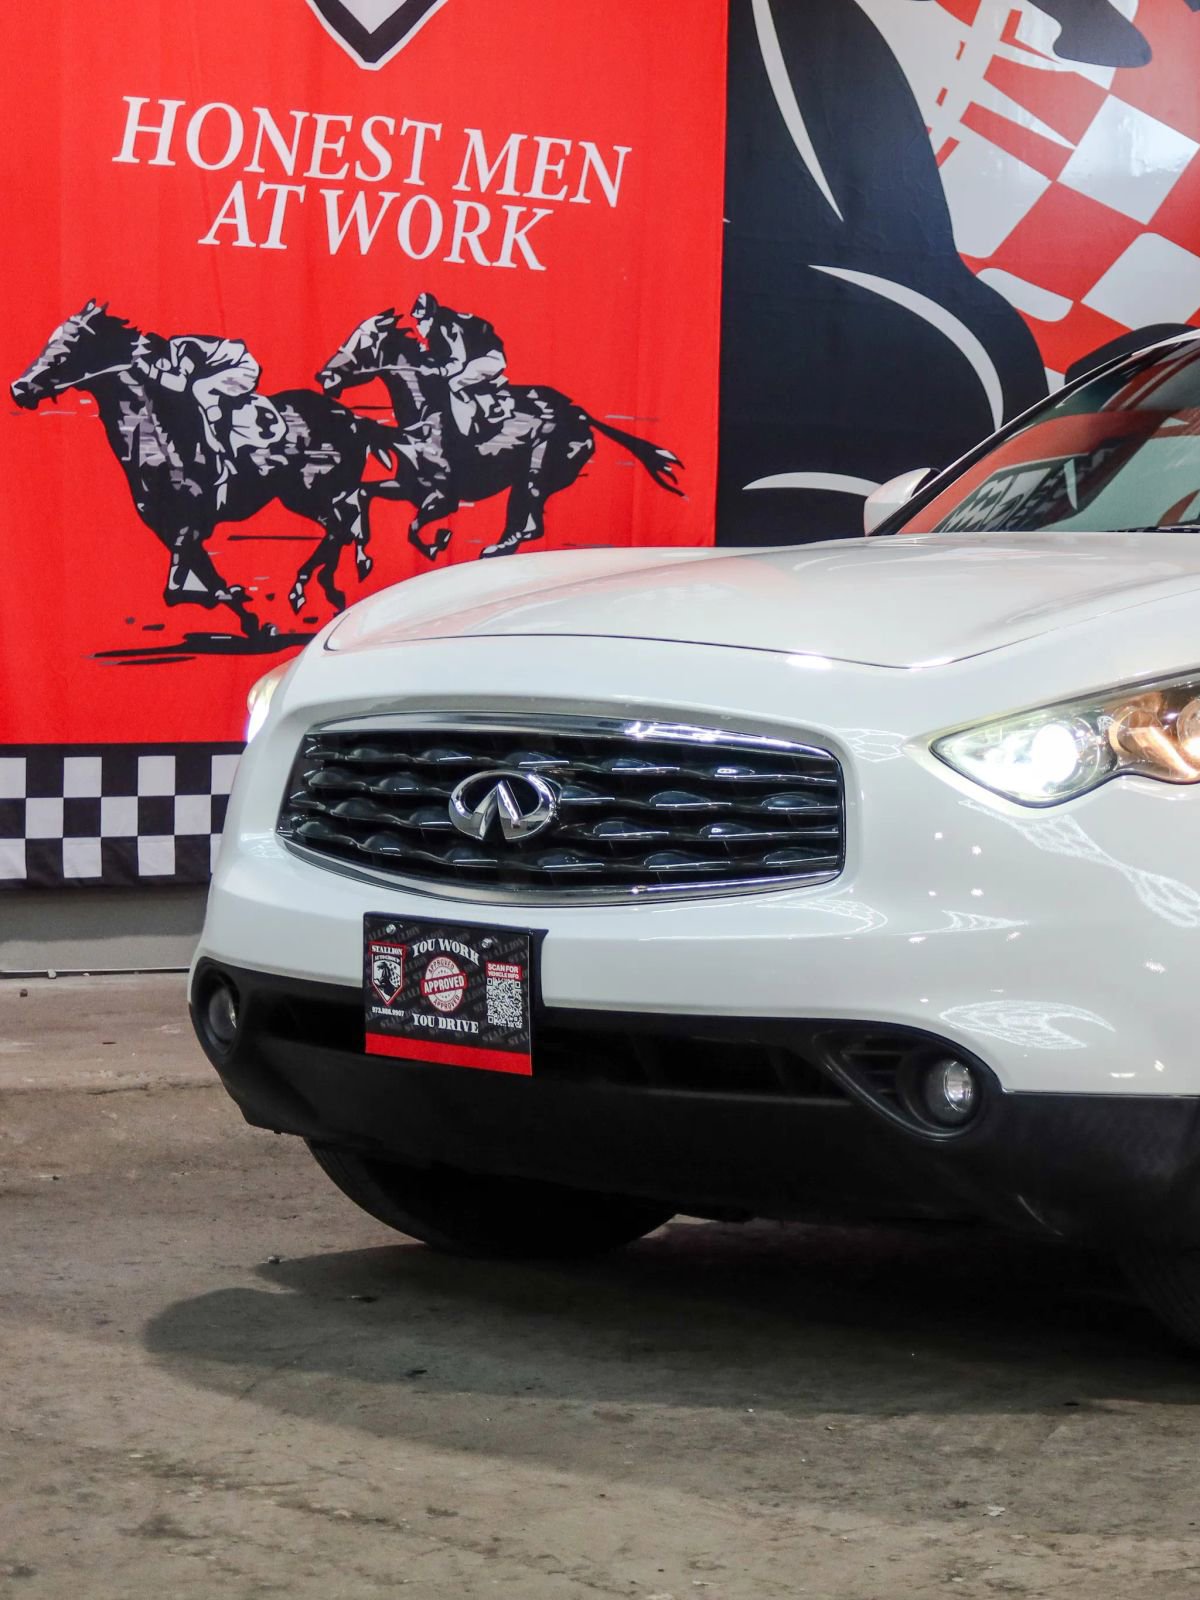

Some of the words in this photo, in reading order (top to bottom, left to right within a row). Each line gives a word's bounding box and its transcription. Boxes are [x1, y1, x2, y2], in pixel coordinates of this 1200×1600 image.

[112, 96, 442, 185] HONEST
[452, 129, 632, 207] MEN
[198, 181, 306, 249] AT
[320, 189, 553, 270] WORK
[371, 945, 403, 955] STALLION
[412, 939, 436, 958] YOU
[438, 938, 480, 966] WORK
[428, 959, 455, 974] APPROVED
[487, 963, 505, 972] SCAN
[505, 965, 519, 973] FOR
[424, 975, 465, 994] APPROVED
[433, 995, 460, 1009] APPROVED
[412, 1013, 435, 1027] YOU
[438, 1016, 479, 1034] DRIVE
